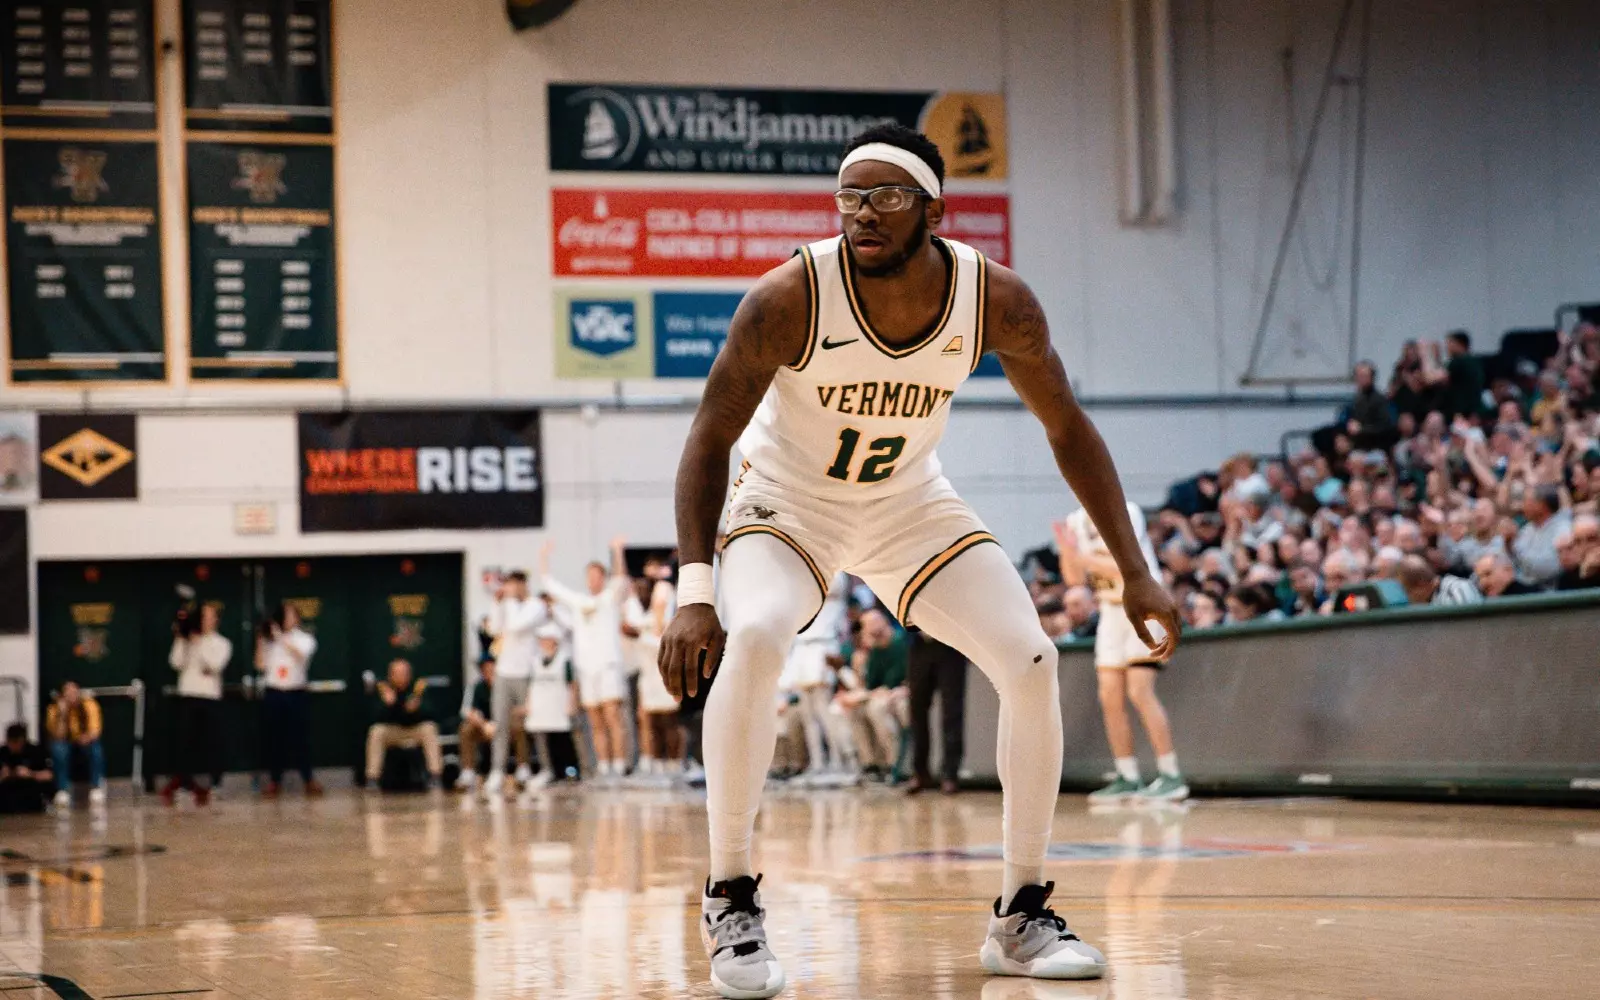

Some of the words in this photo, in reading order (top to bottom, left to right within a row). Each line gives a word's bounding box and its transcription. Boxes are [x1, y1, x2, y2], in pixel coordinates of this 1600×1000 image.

[817, 381, 954, 419] VERMONT
[417, 446, 538, 494] RISE
[825, 426, 908, 483] 12
